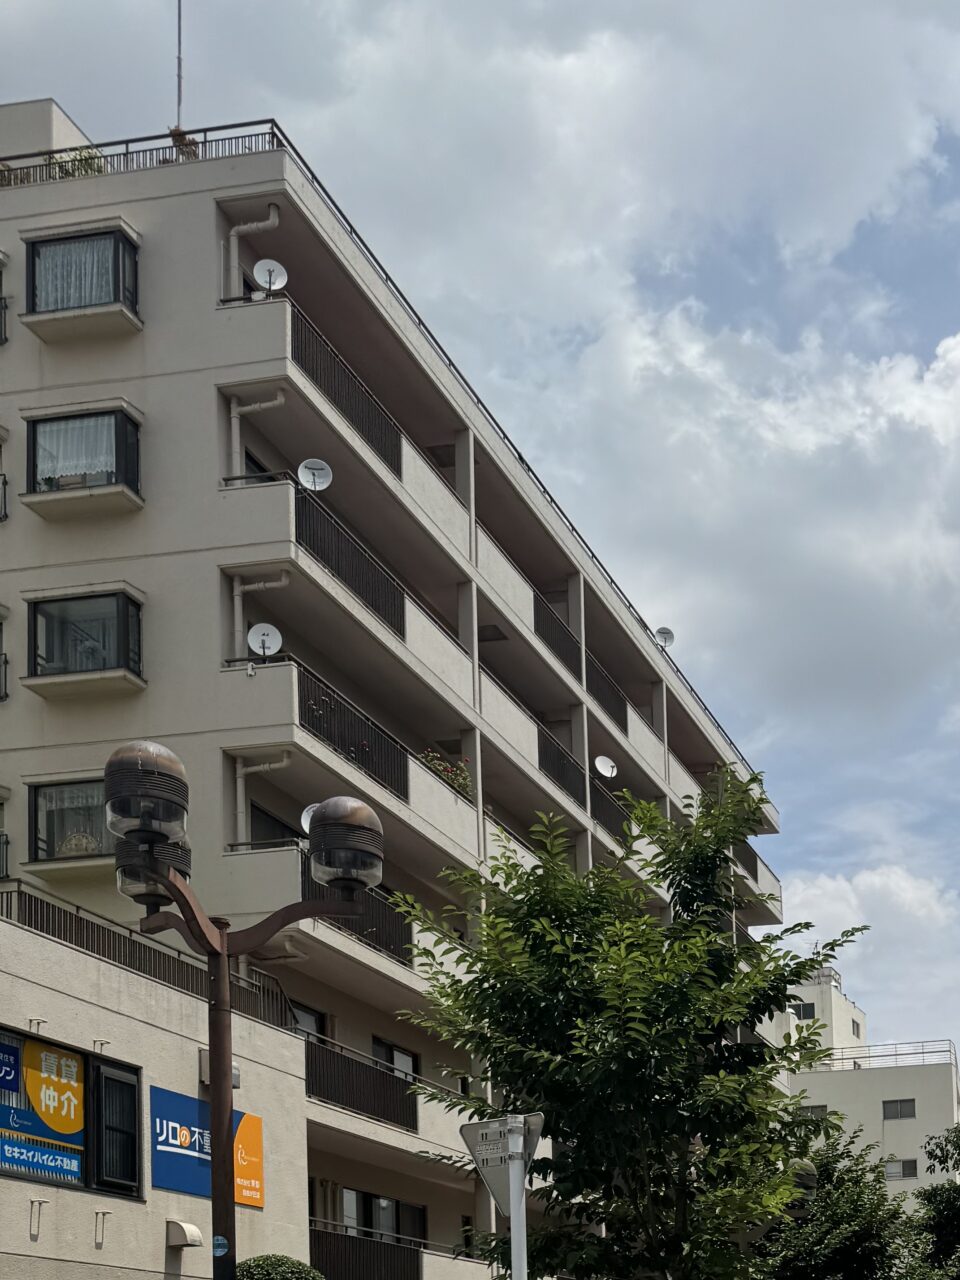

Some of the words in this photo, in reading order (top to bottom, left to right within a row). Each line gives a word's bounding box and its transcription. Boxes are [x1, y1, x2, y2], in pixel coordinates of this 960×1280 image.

[40, 1051, 78, 1088] 賃貸
[40, 1084, 79, 1120] 仲介
[4, 1144, 80, 1172] セキスイハイム不動産
